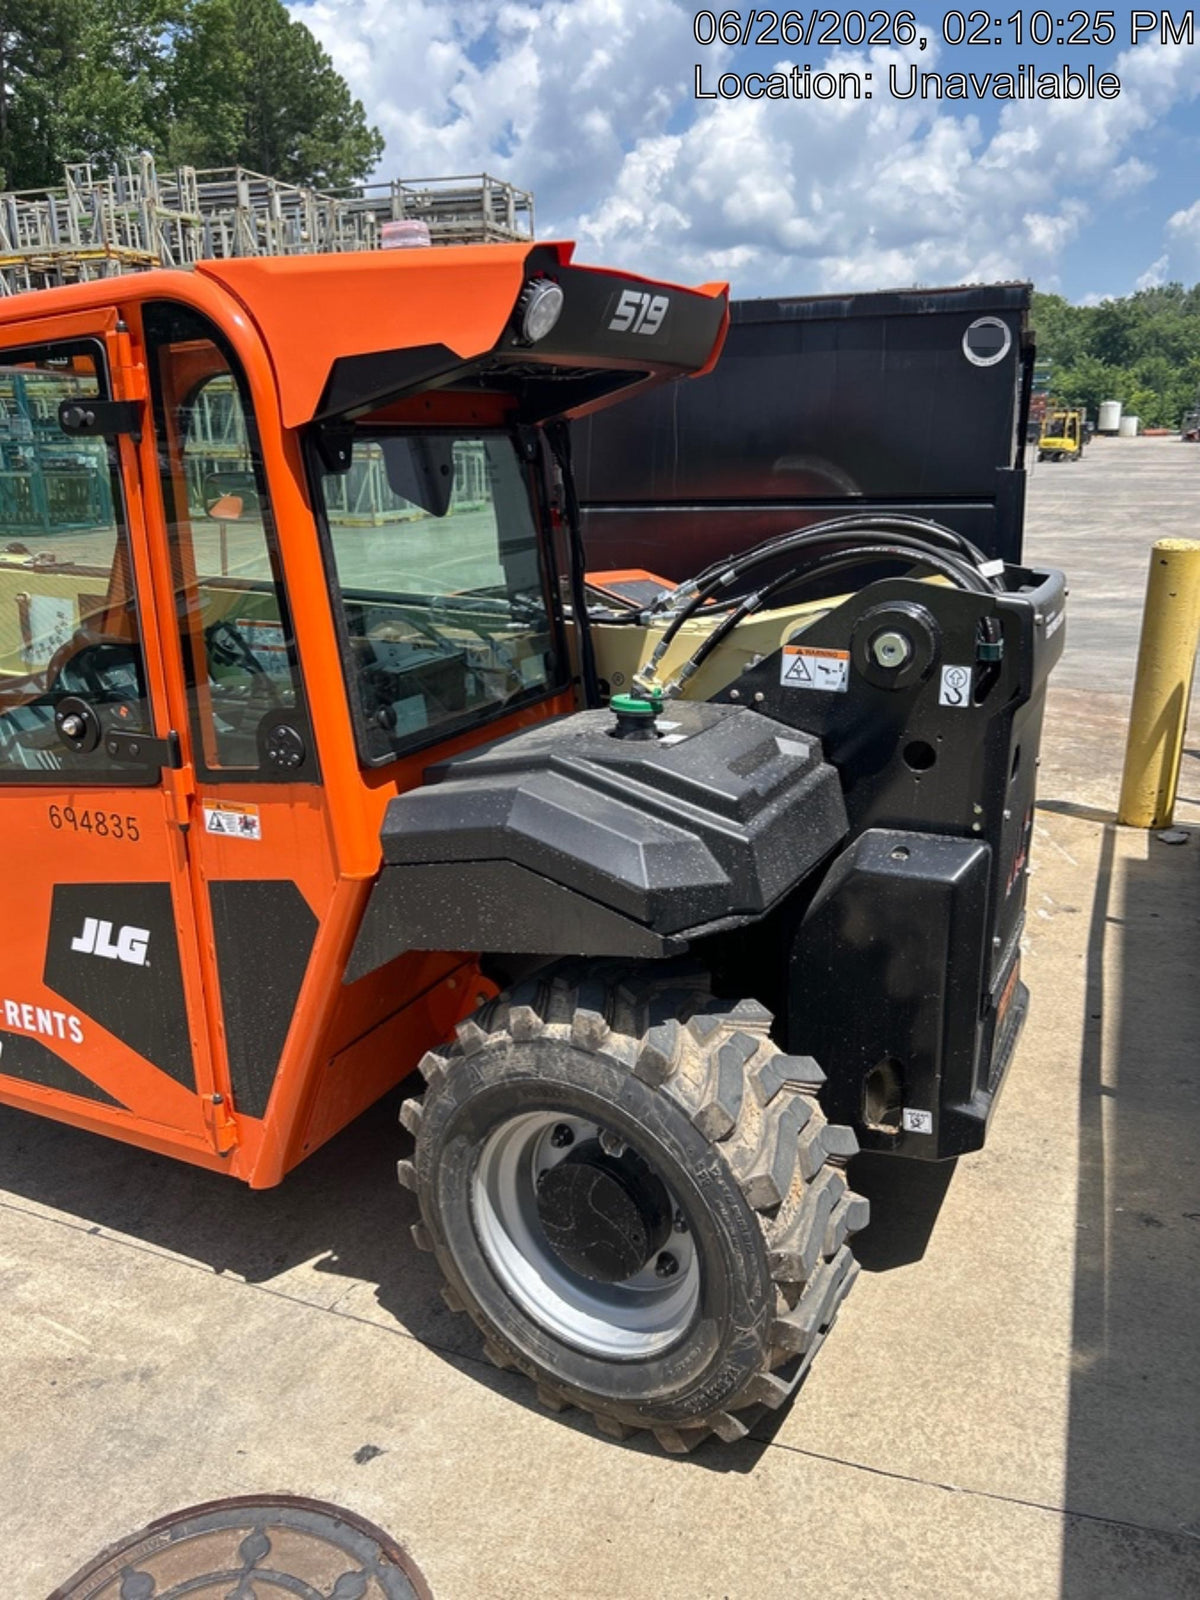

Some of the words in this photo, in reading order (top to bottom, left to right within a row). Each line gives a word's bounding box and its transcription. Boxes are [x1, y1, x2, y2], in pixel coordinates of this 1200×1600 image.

[608, 289, 669, 335] 519
[49, 804, 140, 842] 694835
[70, 916, 150, 967] JLG
